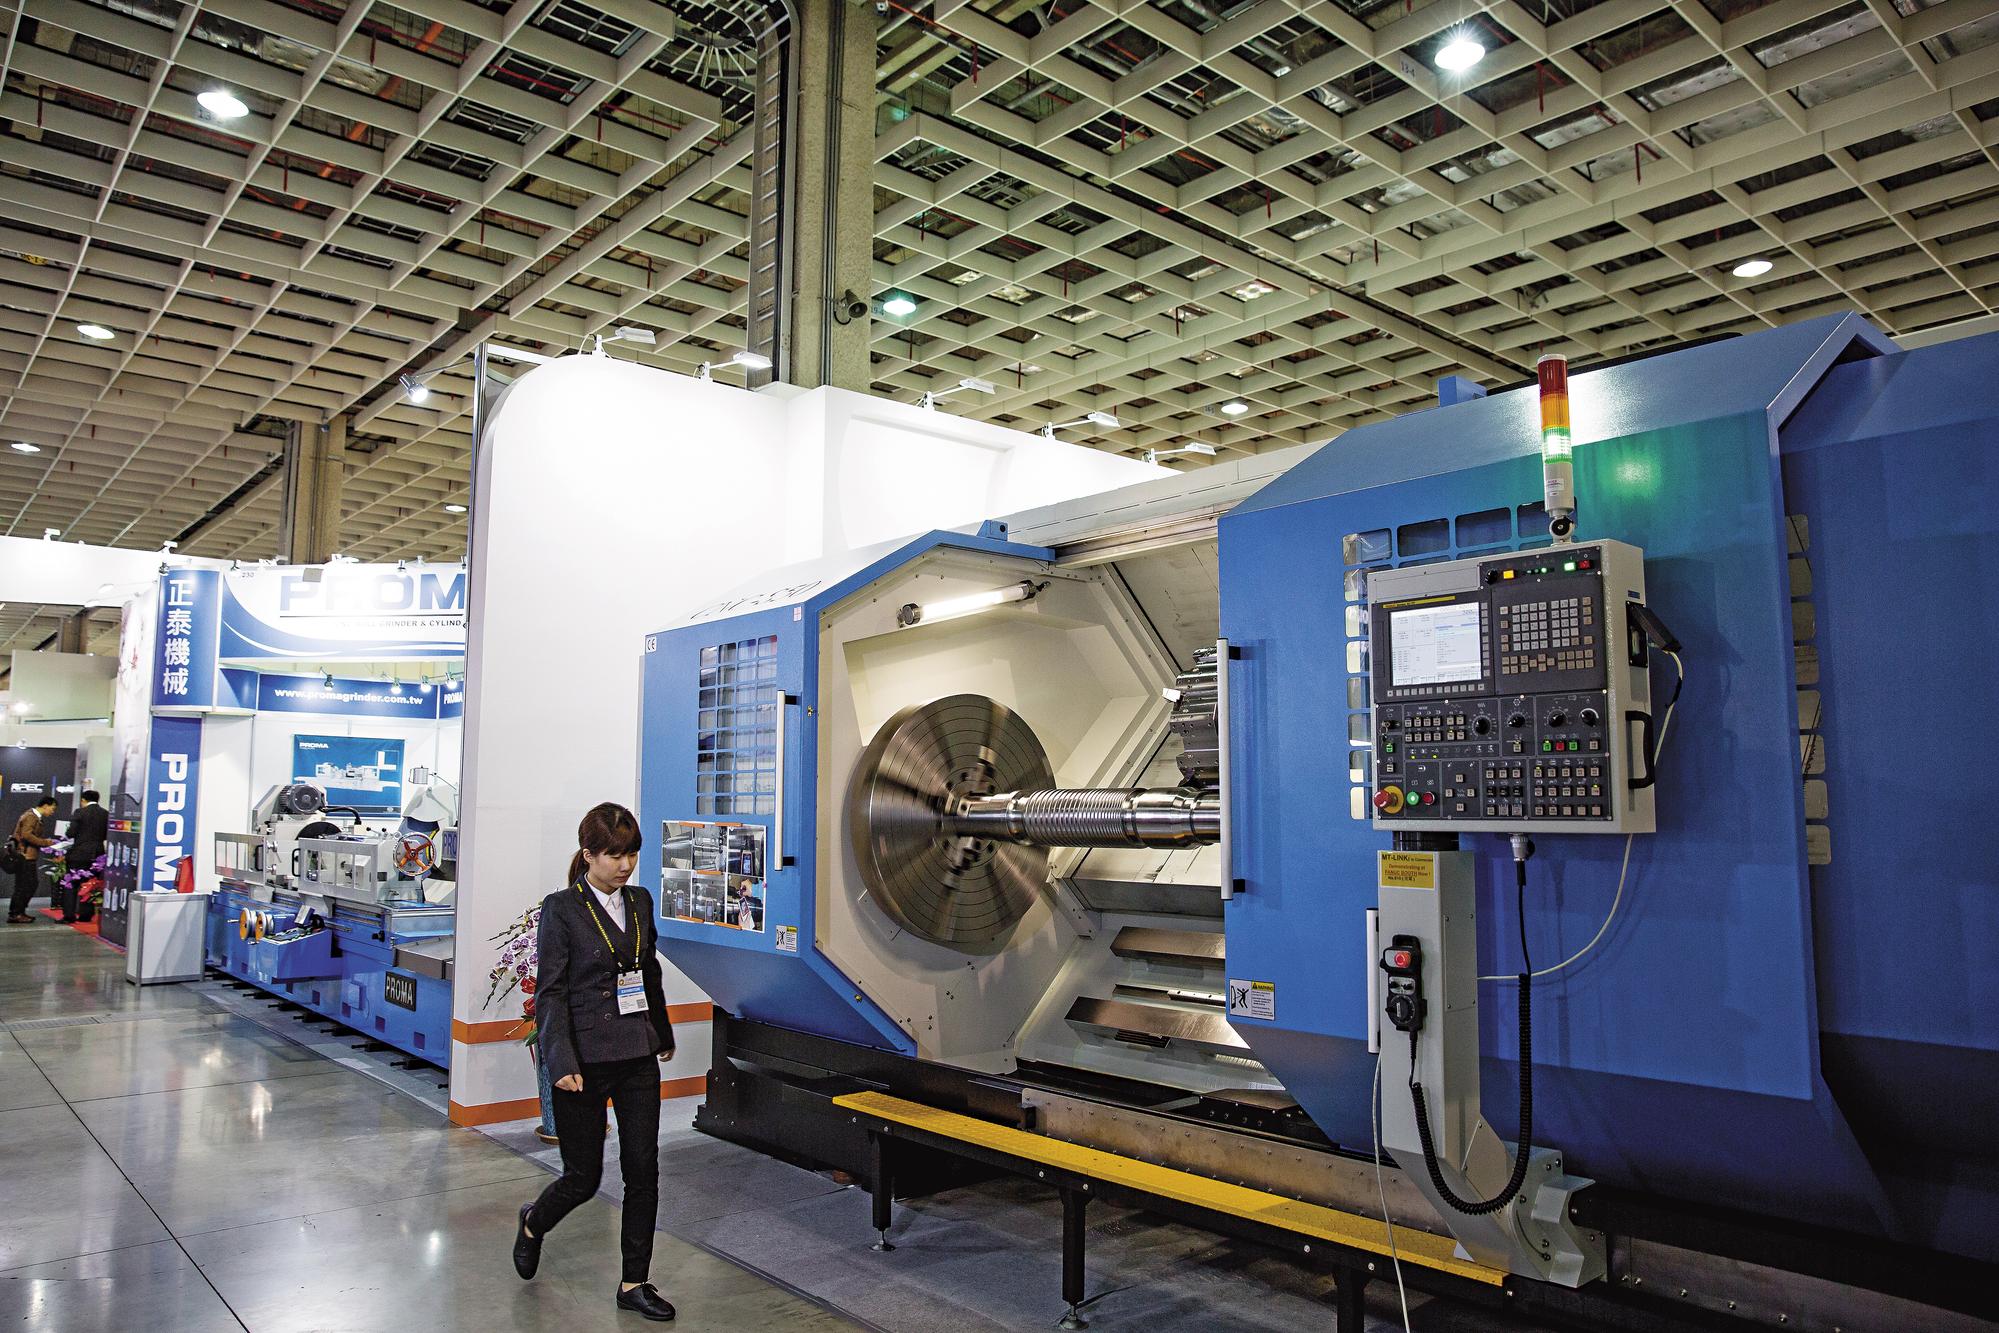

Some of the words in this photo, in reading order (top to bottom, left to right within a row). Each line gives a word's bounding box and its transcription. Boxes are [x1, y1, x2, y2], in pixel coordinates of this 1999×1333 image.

[161, 579, 194, 696] 正泰機械
[274, 688, 424, 705] www.promagrinder.com.tw
[152, 753, 189, 893] PROM
[385, 975, 414, 1006] PROMA
